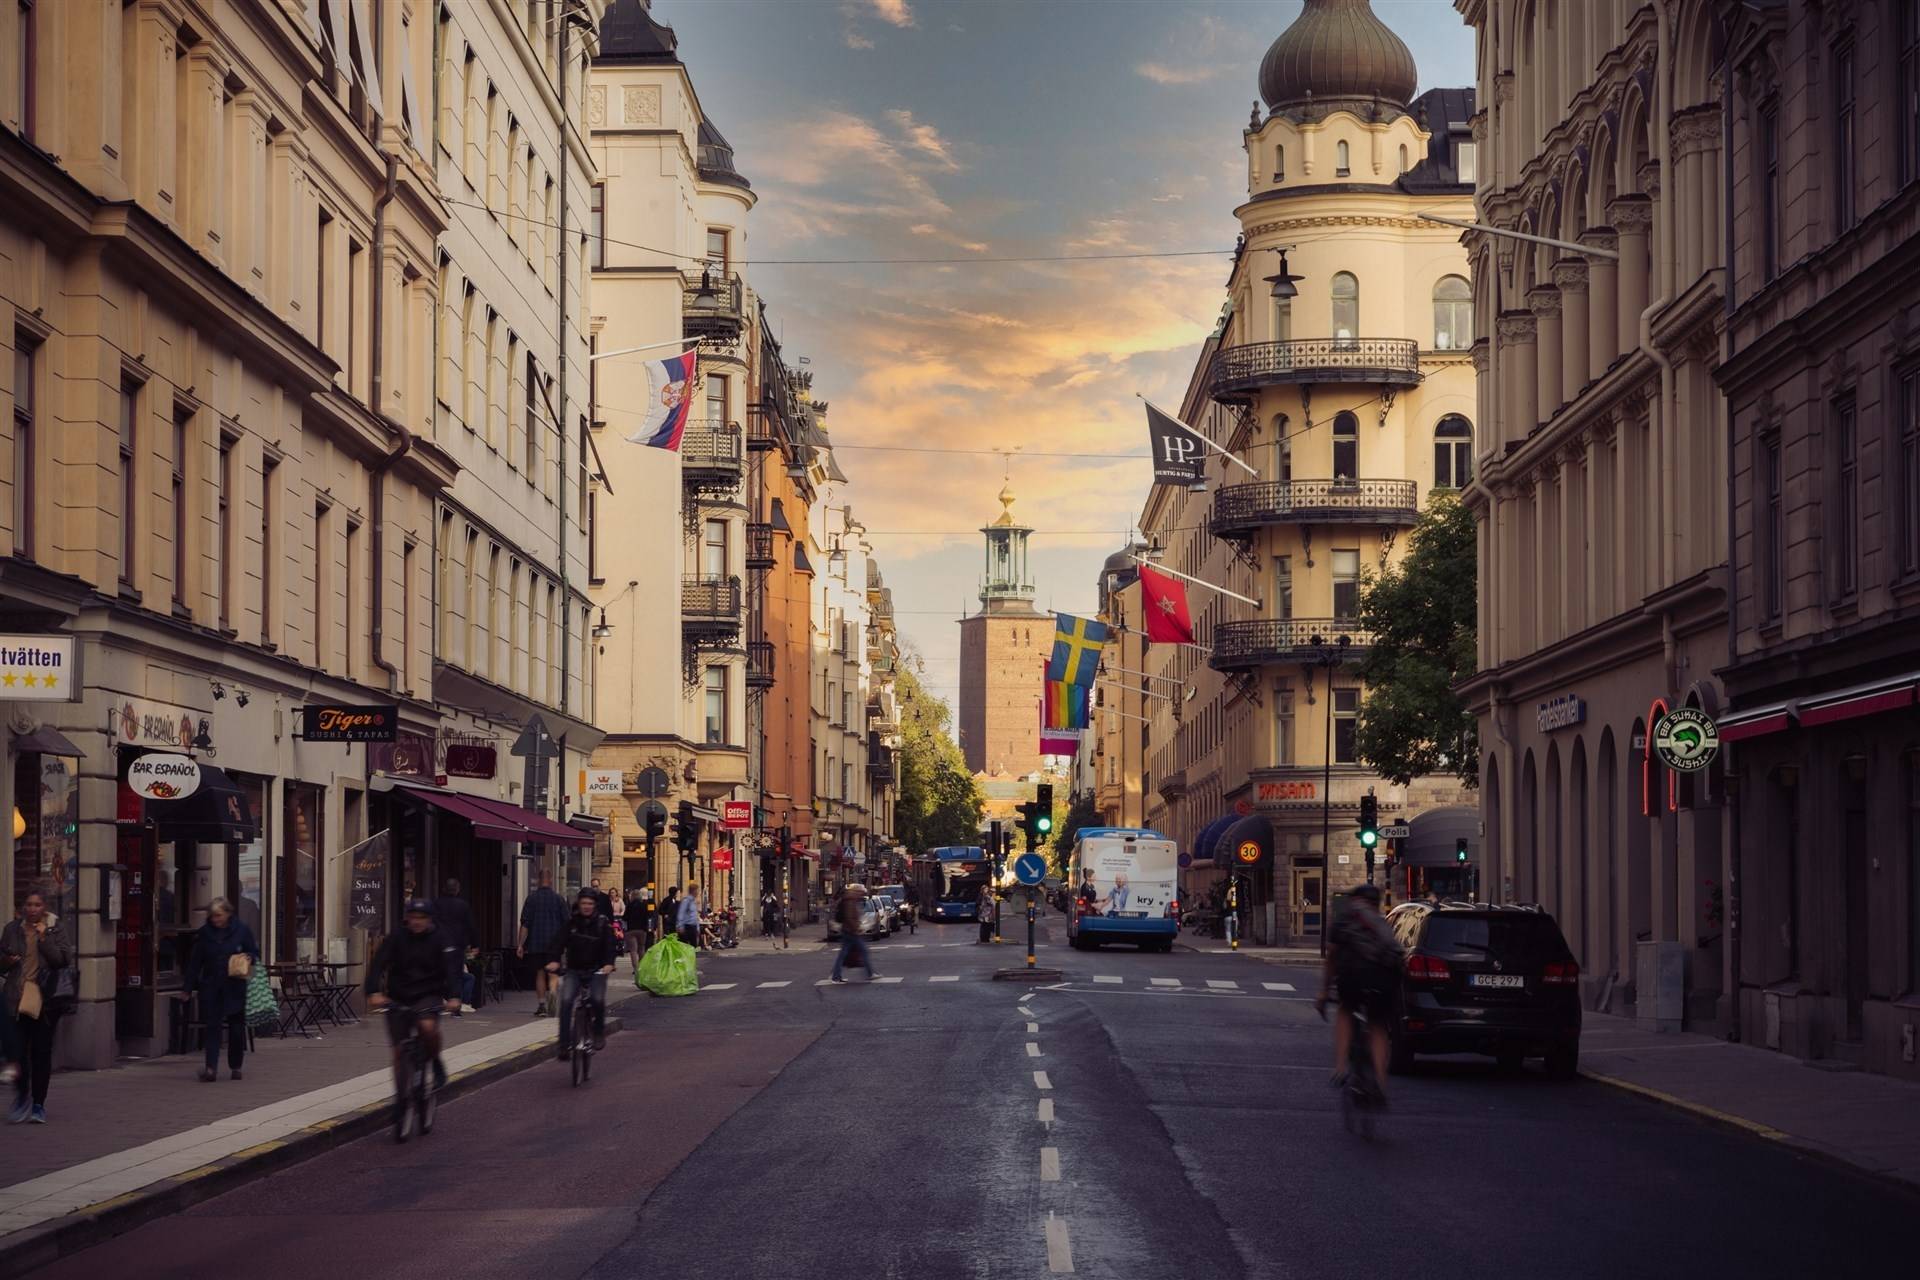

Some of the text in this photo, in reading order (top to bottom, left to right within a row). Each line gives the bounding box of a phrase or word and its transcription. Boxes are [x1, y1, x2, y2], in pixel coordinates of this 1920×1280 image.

[1, 647, 61, 667] tvätten
[319, 708, 372, 731] Tiger
[346, 730, 352, 739] &
[1671, 756, 1705, 769] SUSHI
[133, 762, 195, 776] BAR ESPAÑOL
[589, 783, 619, 791] APOTEK
[1385, 828, 1407, 836] Polis
[1242, 847, 1257, 857] 30
[356, 880, 381, 889] Sushi
[364, 893, 371, 902] &
[1137, 896, 1154, 905] kry
[356, 905, 376, 914] Wok
[1478, 976, 1519, 985] GCE 297
